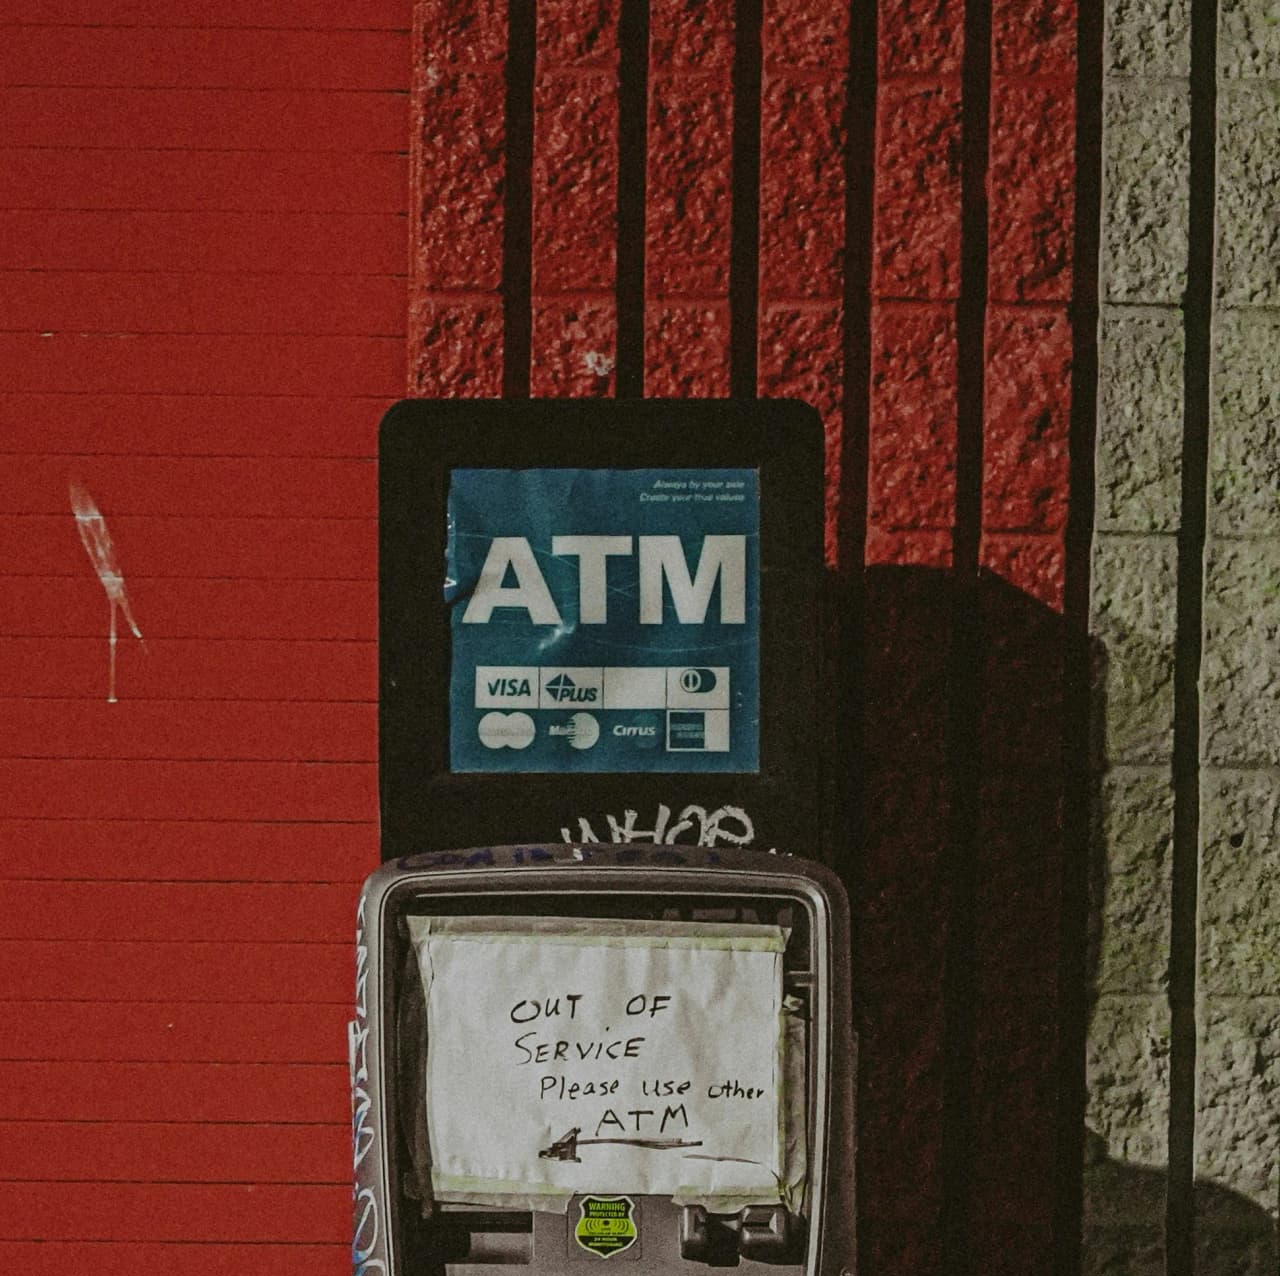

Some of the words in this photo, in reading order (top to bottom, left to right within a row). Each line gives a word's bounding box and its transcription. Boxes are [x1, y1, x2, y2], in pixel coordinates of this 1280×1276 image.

[461, 535, 746, 624] ATM
[488, 678, 531, 697] VISA
[559, 687, 598, 702] PLUS
[613, 724, 656, 736] Cirrus
[510, 994, 583, 1024] OUT
[626, 994, 672, 1018] OF
[514, 1029, 646, 1065] SERVICE
[540, 1075, 619, 1100] Please
[708, 1079, 765, 1100] other
[596, 1104, 689, 1137] ATM
[588, 1201, 625, 1211] WARNING
